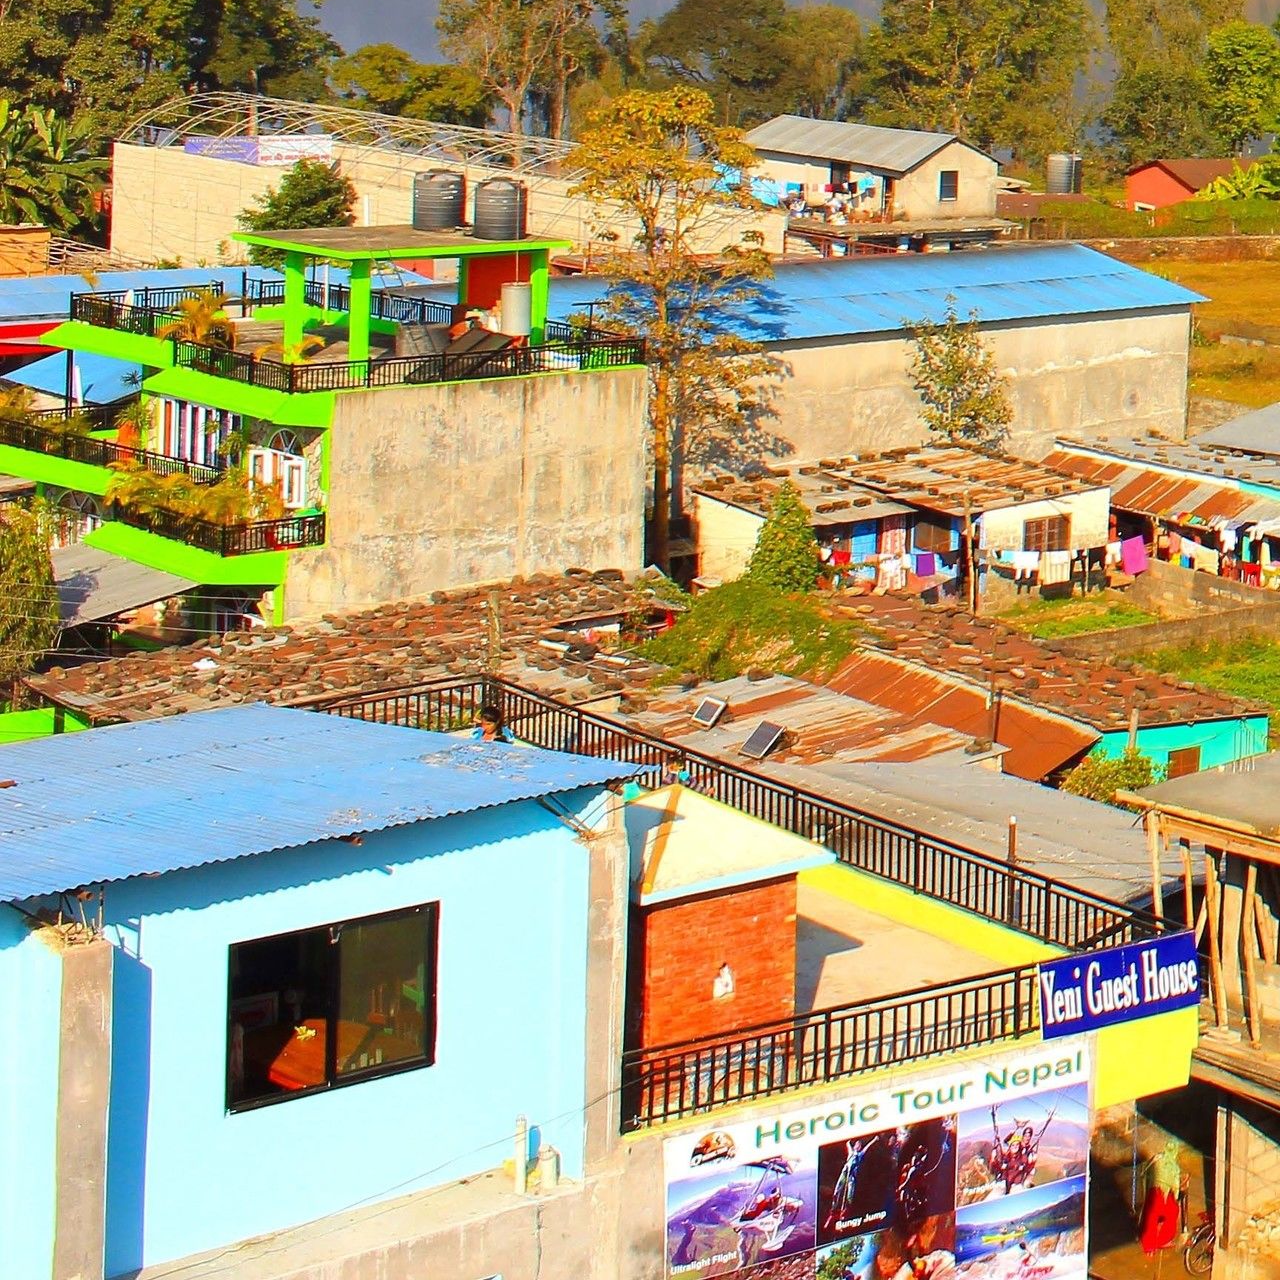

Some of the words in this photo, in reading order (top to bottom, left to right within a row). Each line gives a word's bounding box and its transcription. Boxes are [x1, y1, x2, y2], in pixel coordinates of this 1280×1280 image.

[1041, 967, 1083, 1024] Yeni
[1087, 961, 1140, 1015] Guest
[1142, 949, 1198, 1002] House
[755, 1101, 880, 1148] Heroic
[891, 1081, 974, 1113] Tour
[984, 1050, 1083, 1094] Nepal
[835, 1216, 863, 1231] Bungy
[863, 1210, 887, 1225] Jump
[670, 1258, 711, 1276] Ultralight
[712, 1251, 738, 1267] Flight
